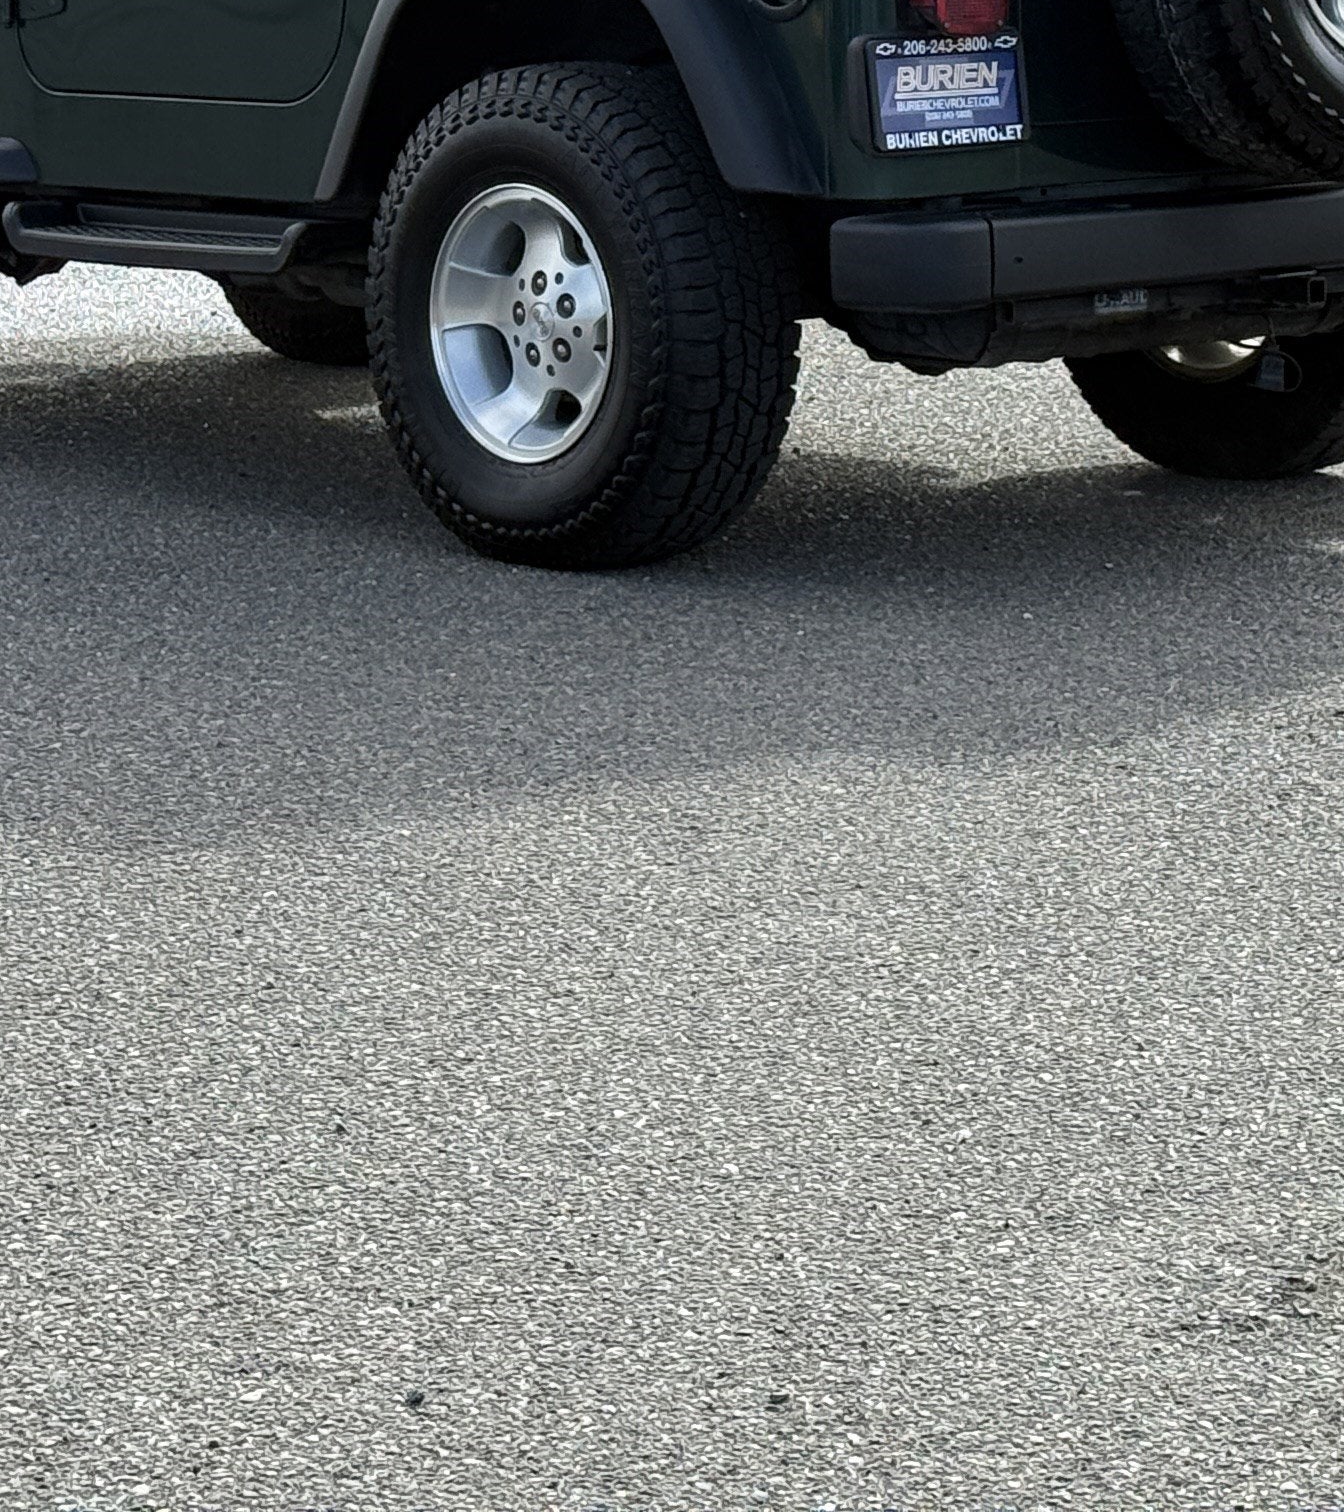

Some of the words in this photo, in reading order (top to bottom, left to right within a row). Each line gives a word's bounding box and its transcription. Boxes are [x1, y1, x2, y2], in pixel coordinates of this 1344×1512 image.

[903, 36, 987, 55] 206-243-5800
[896, 61, 998, 92] BURIEN
[885, 130, 938, 150] BURIEN
[941, 124, 1023, 145] CHEVROLET
